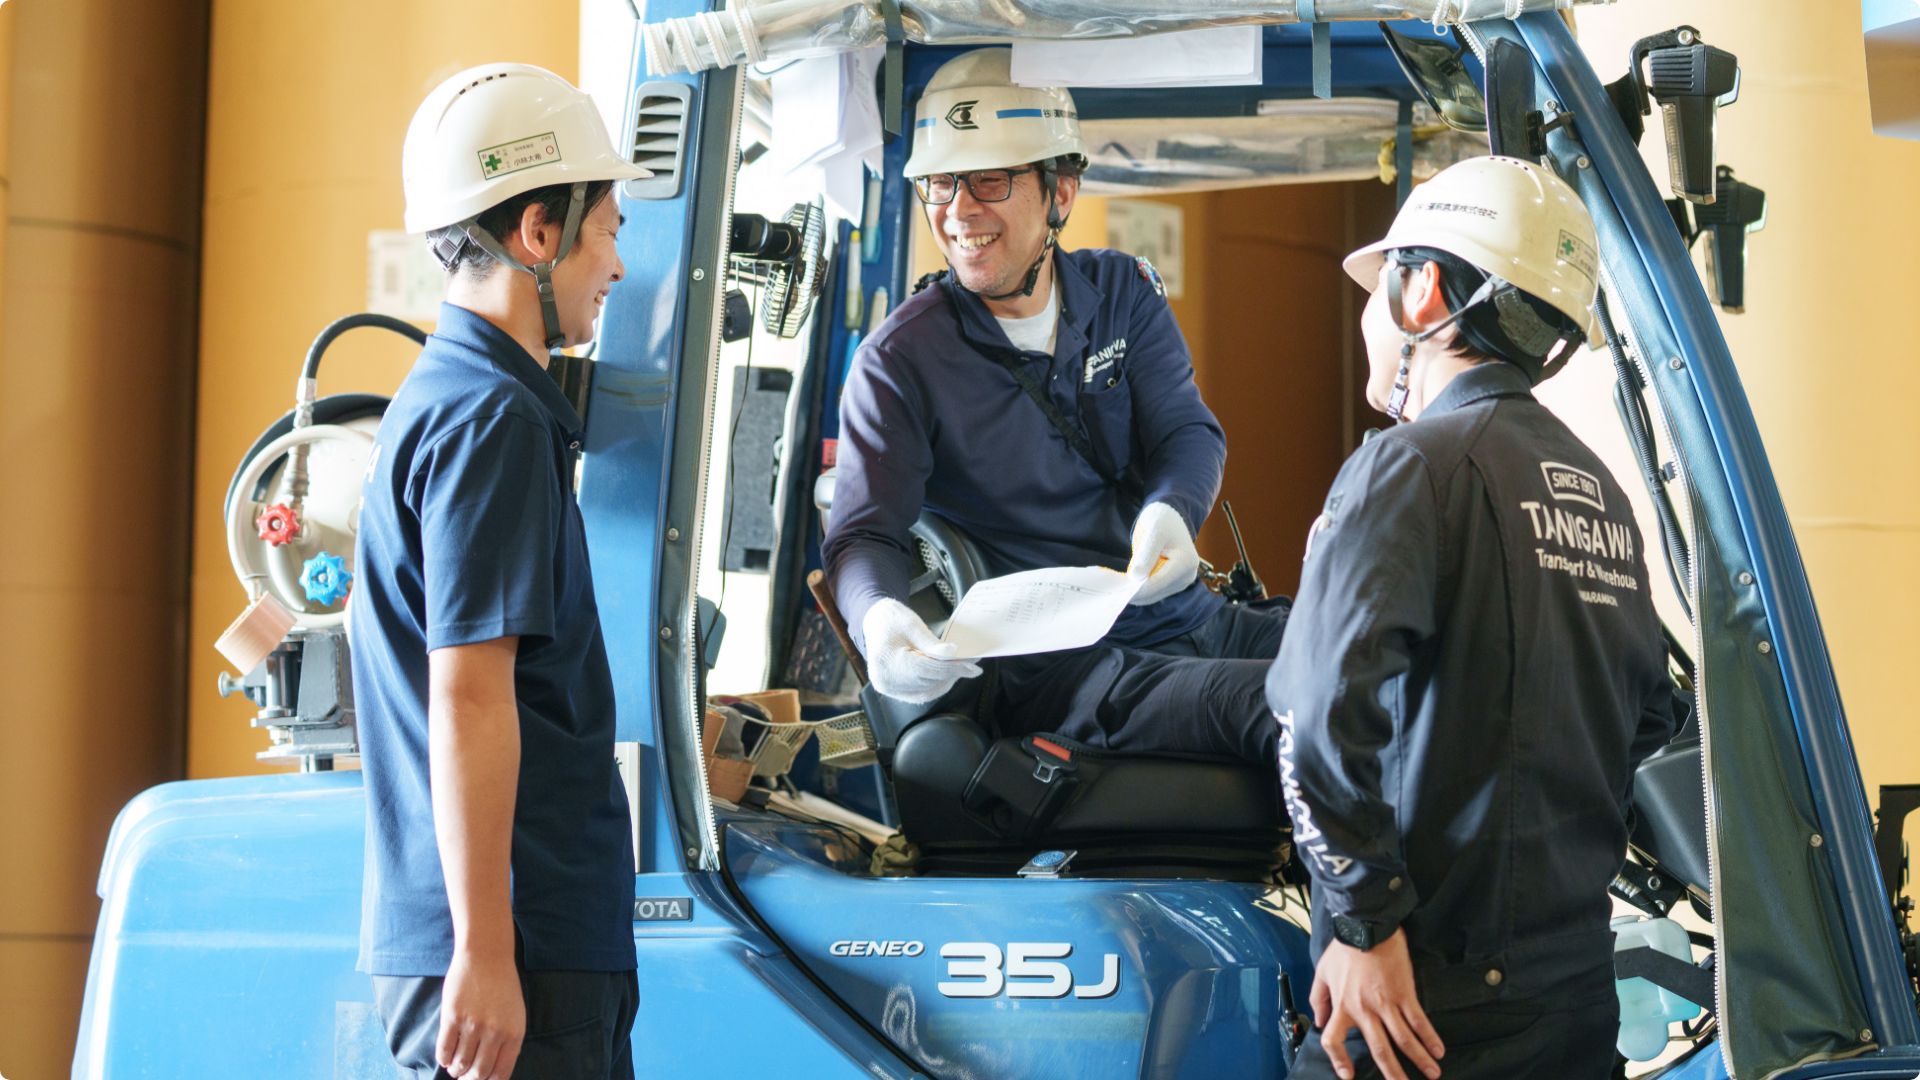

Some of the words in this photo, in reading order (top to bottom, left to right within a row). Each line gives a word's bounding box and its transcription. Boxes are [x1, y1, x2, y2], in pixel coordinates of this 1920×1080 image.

[1552, 473, 1579, 490] SINCE
[1520, 501, 1634, 562] TANIGAWA
[1535, 548, 1584, 577] Transrt
[1587, 560, 1597, 579] &
[1594, 562, 1638, 591] Wrehoue
[635, 901, 683, 918] OTA
[829, 940, 925, 957] GENEO
[937, 942, 1119, 999] 35J
